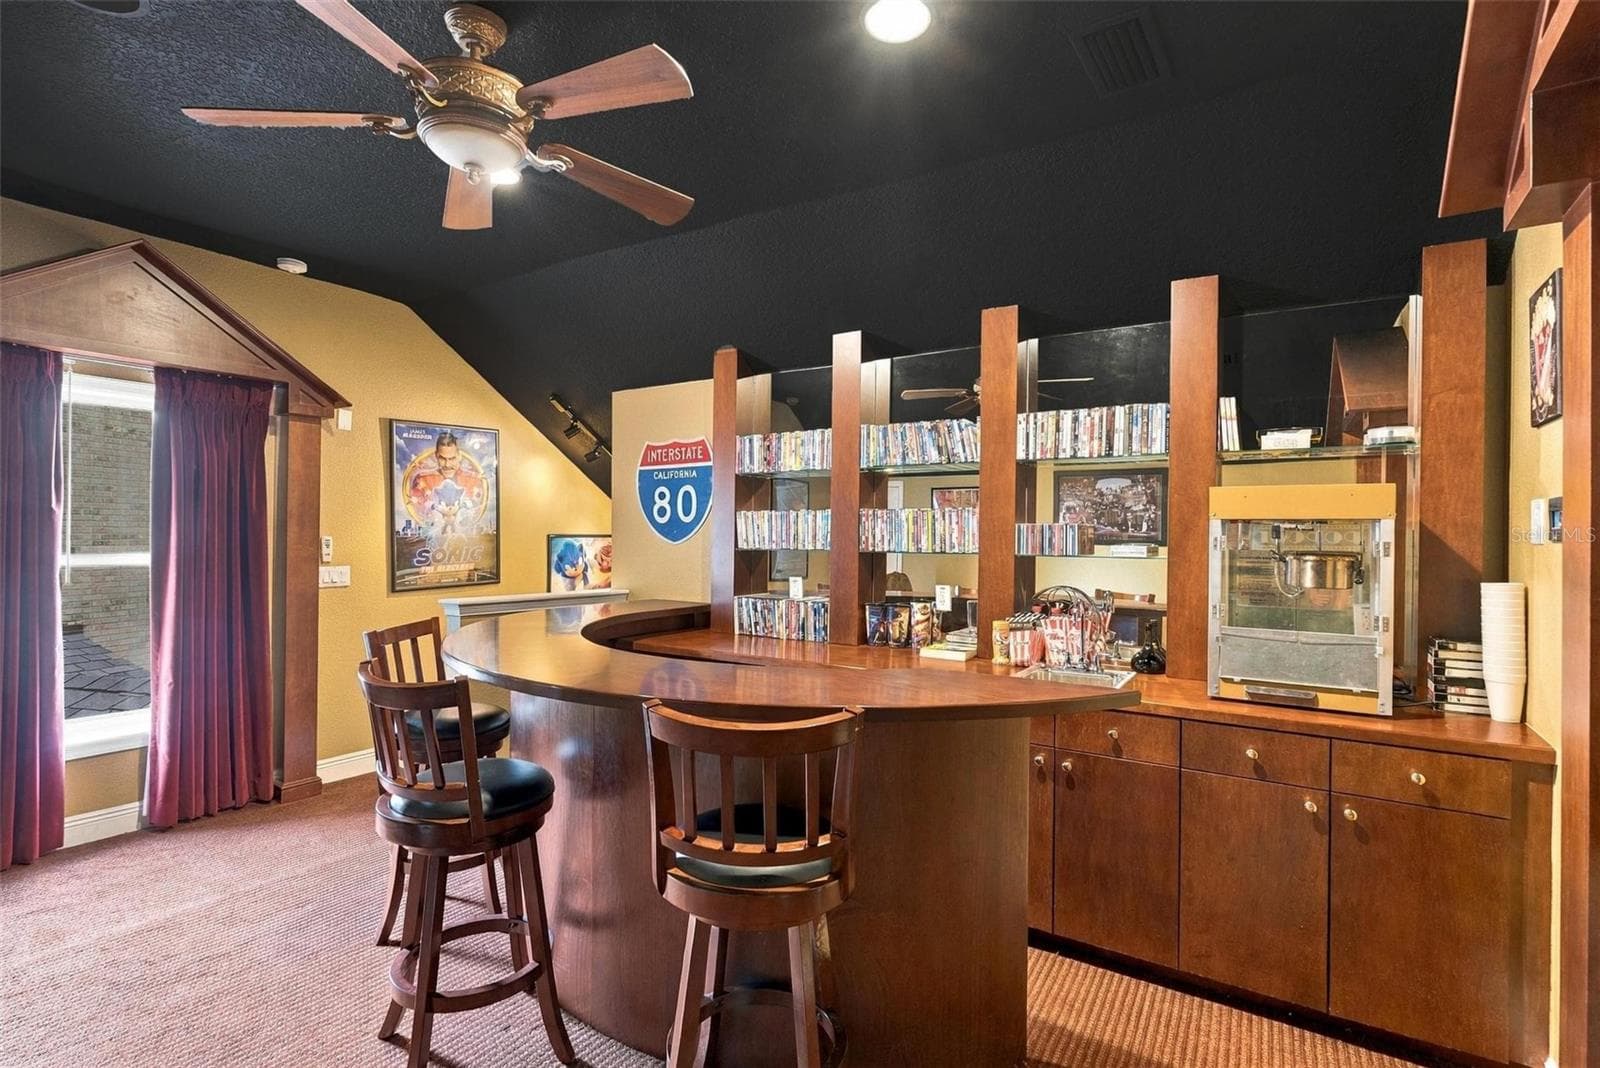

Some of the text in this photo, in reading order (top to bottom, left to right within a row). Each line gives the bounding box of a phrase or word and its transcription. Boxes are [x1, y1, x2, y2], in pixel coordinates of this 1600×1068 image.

[648, 446, 703, 462] INTERSTATE
[653, 469, 698, 480] CALIFORNIA
[653, 484, 698, 524] 80
[414, 547, 484, 566] SONIC
